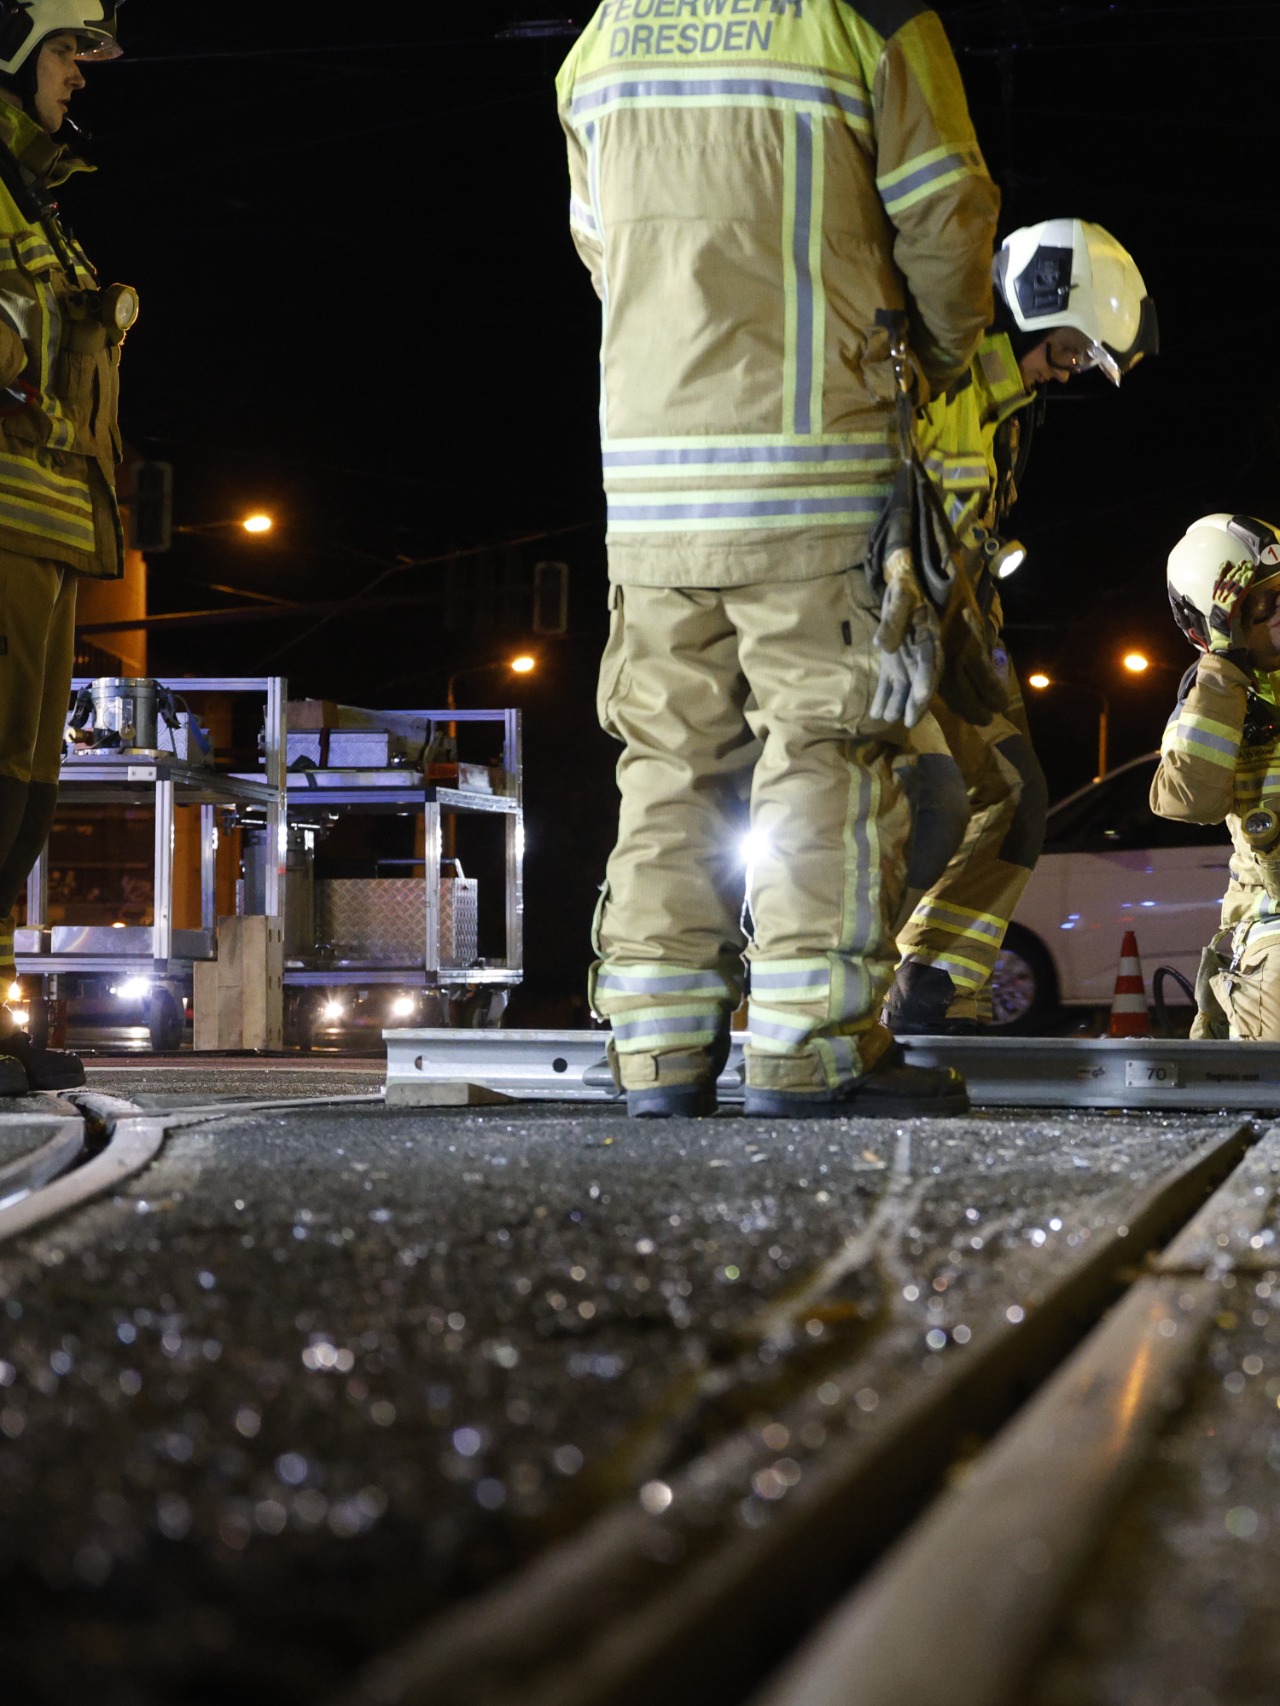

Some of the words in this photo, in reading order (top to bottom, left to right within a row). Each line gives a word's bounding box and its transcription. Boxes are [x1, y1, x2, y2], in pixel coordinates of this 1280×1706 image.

[597, 0, 802, 31] FEUERWEHR
[609, 20, 773, 58] DRESDEN
[1268, 546, 1279, 561] 1
[1146, 1068, 1167, 1081] 70
